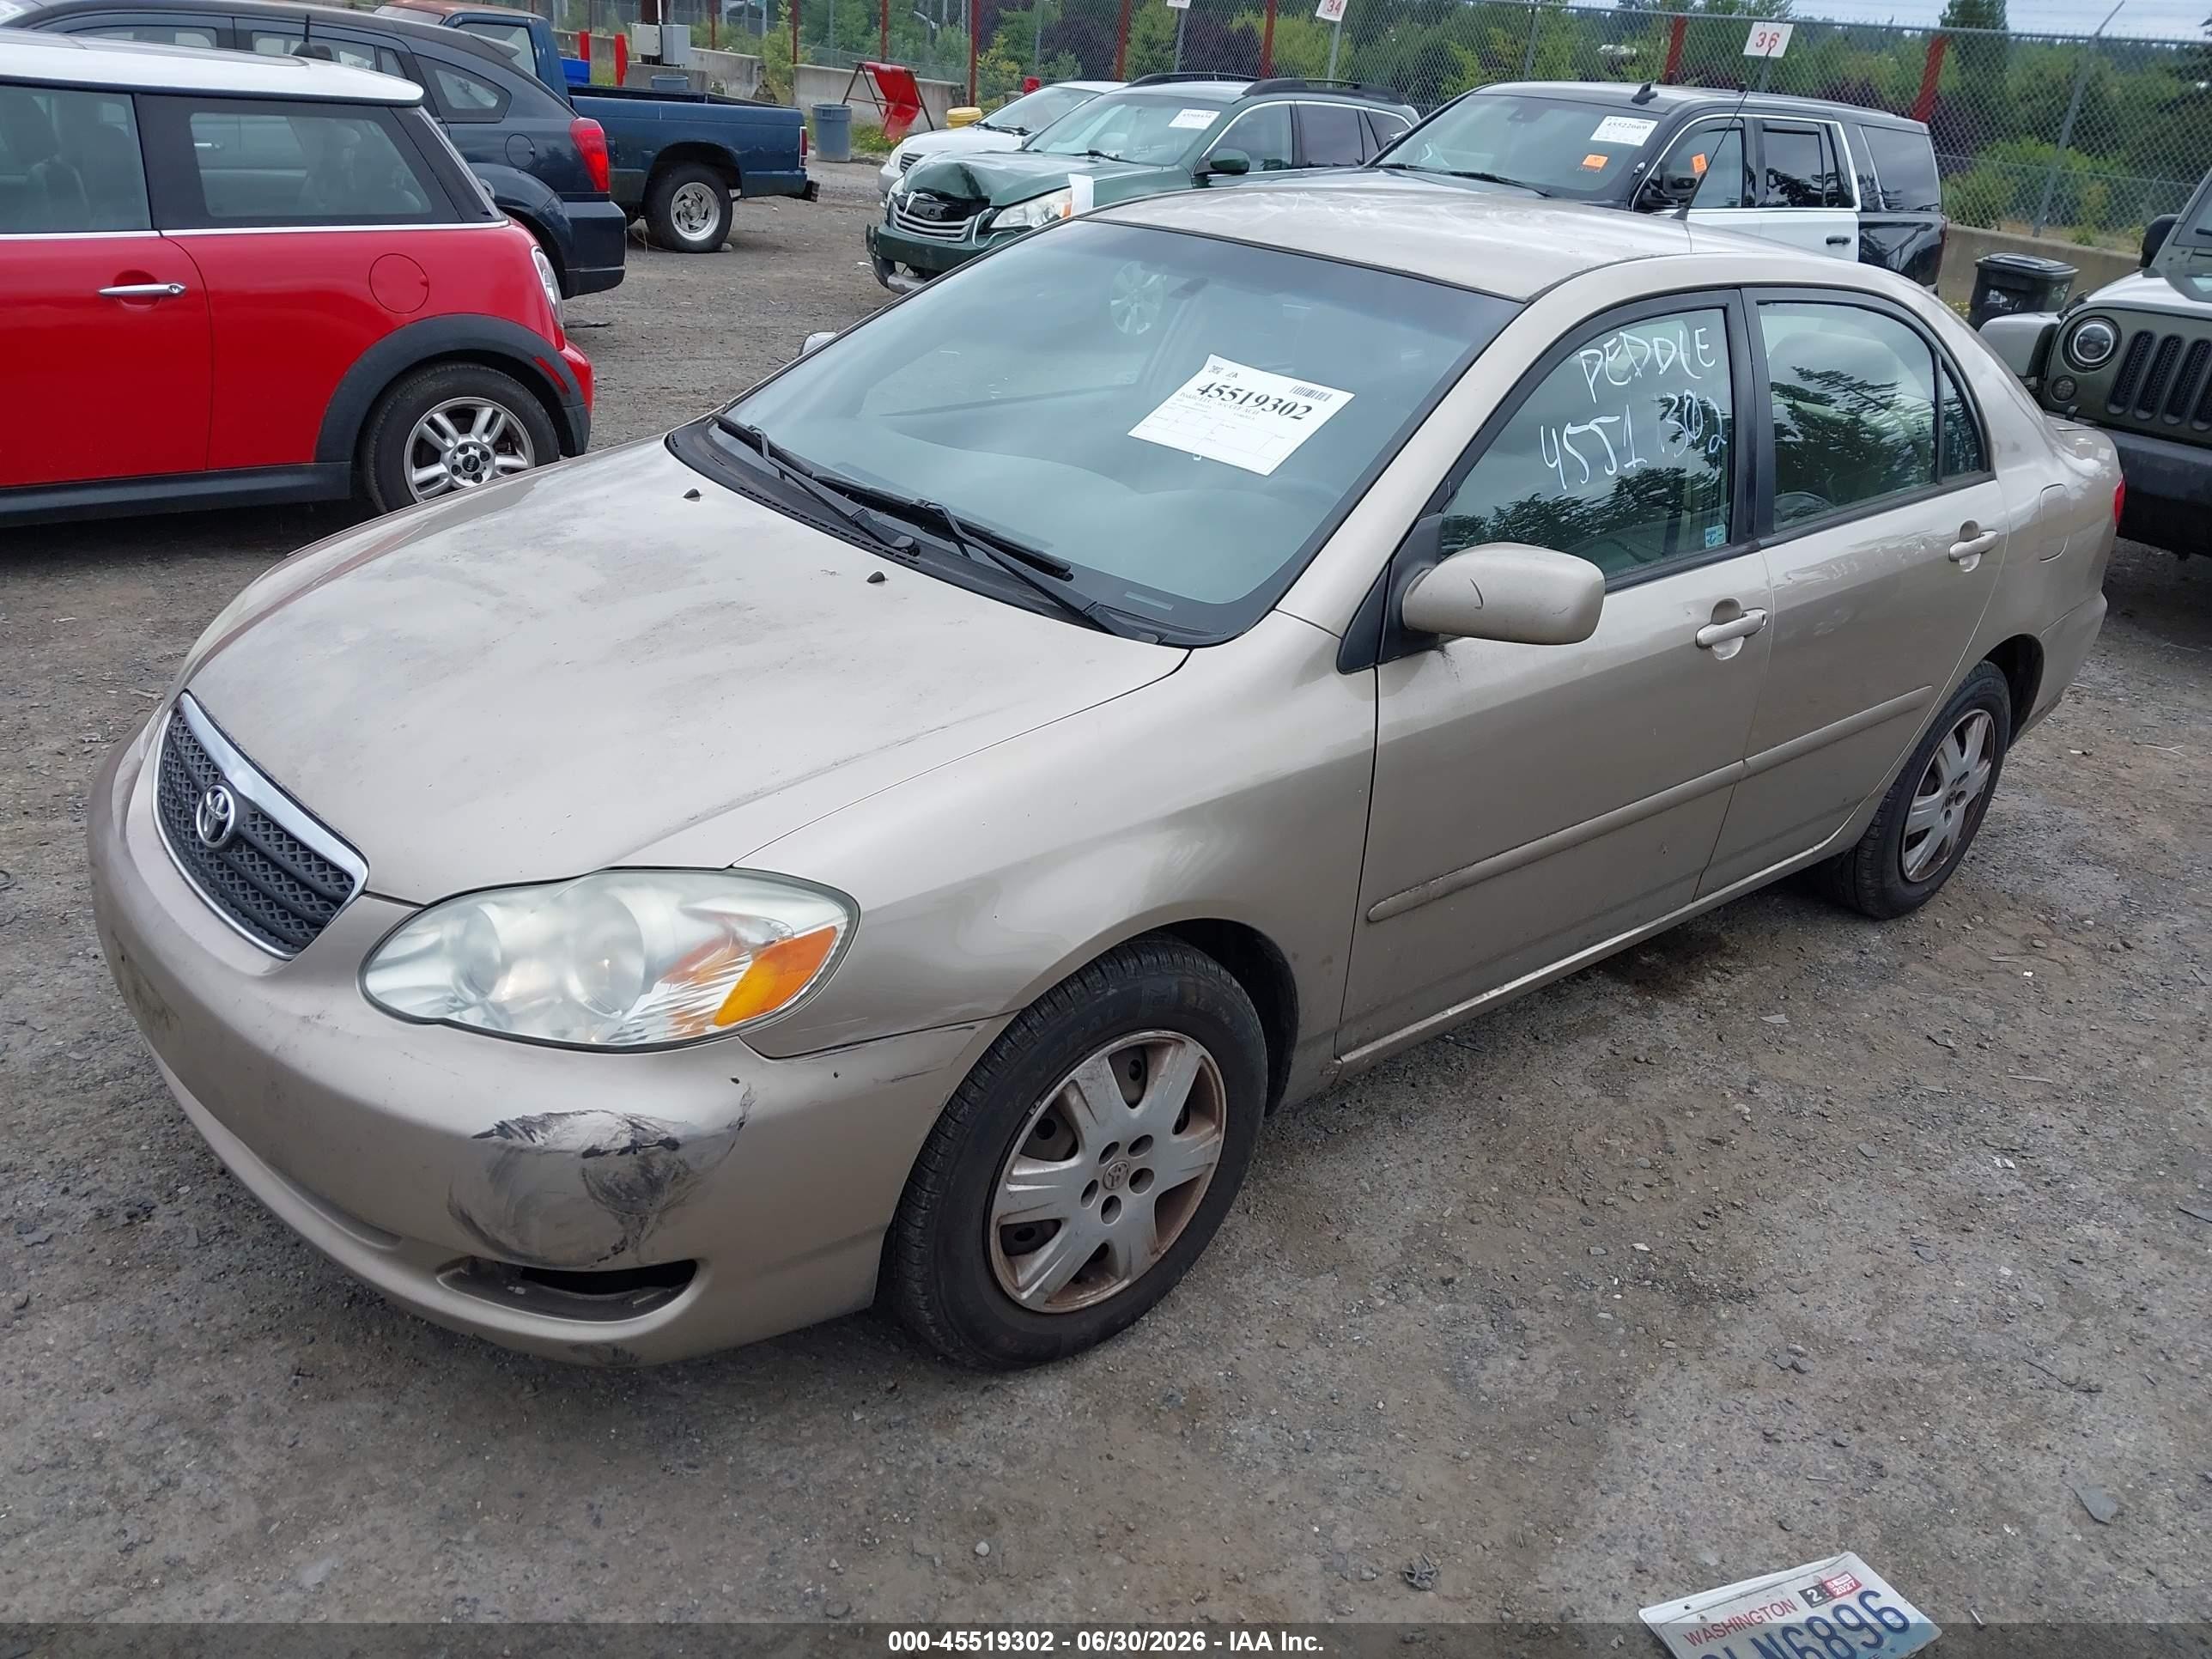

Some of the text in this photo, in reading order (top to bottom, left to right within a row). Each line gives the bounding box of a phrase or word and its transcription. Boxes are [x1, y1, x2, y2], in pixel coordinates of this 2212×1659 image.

[1326, 0, 1342, 14] 34
[1755, 32, 1780, 48] 36
[1578, 328, 1716, 404] PEDDLE
[1195, 381, 1313, 421] 45519302
[1807, 1589, 1822, 1602] 2
[1832, 1580, 1857, 1595] 2027
[1683, 1599, 1798, 1647] WASHINGTON
